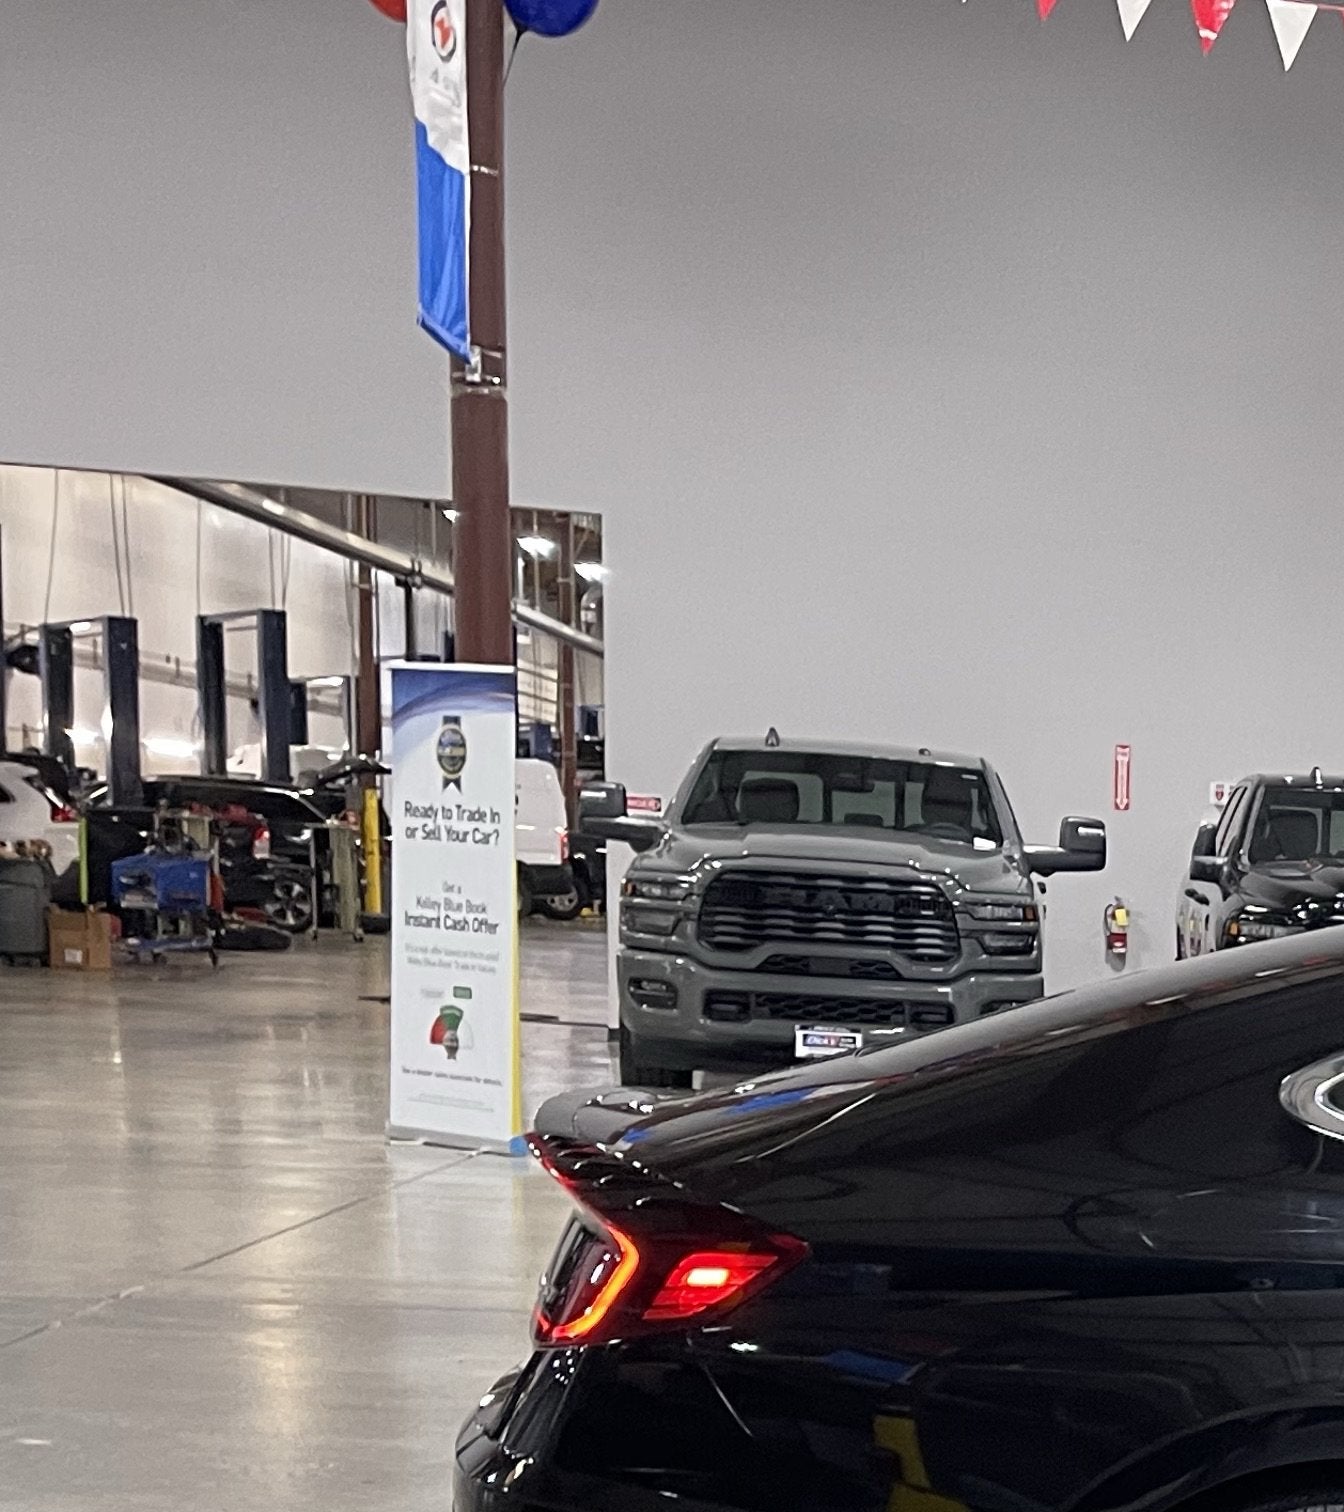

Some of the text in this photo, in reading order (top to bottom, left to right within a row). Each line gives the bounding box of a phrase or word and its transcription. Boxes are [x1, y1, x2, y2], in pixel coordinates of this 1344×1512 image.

[404, 800, 501, 824] Ready to Trade In
[405, 823, 500, 845] or Sell Your Car?
[443, 897, 464, 912] Blue
[465, 899, 487, 915] Book
[404, 911, 500, 935] Instant Cash Offer
